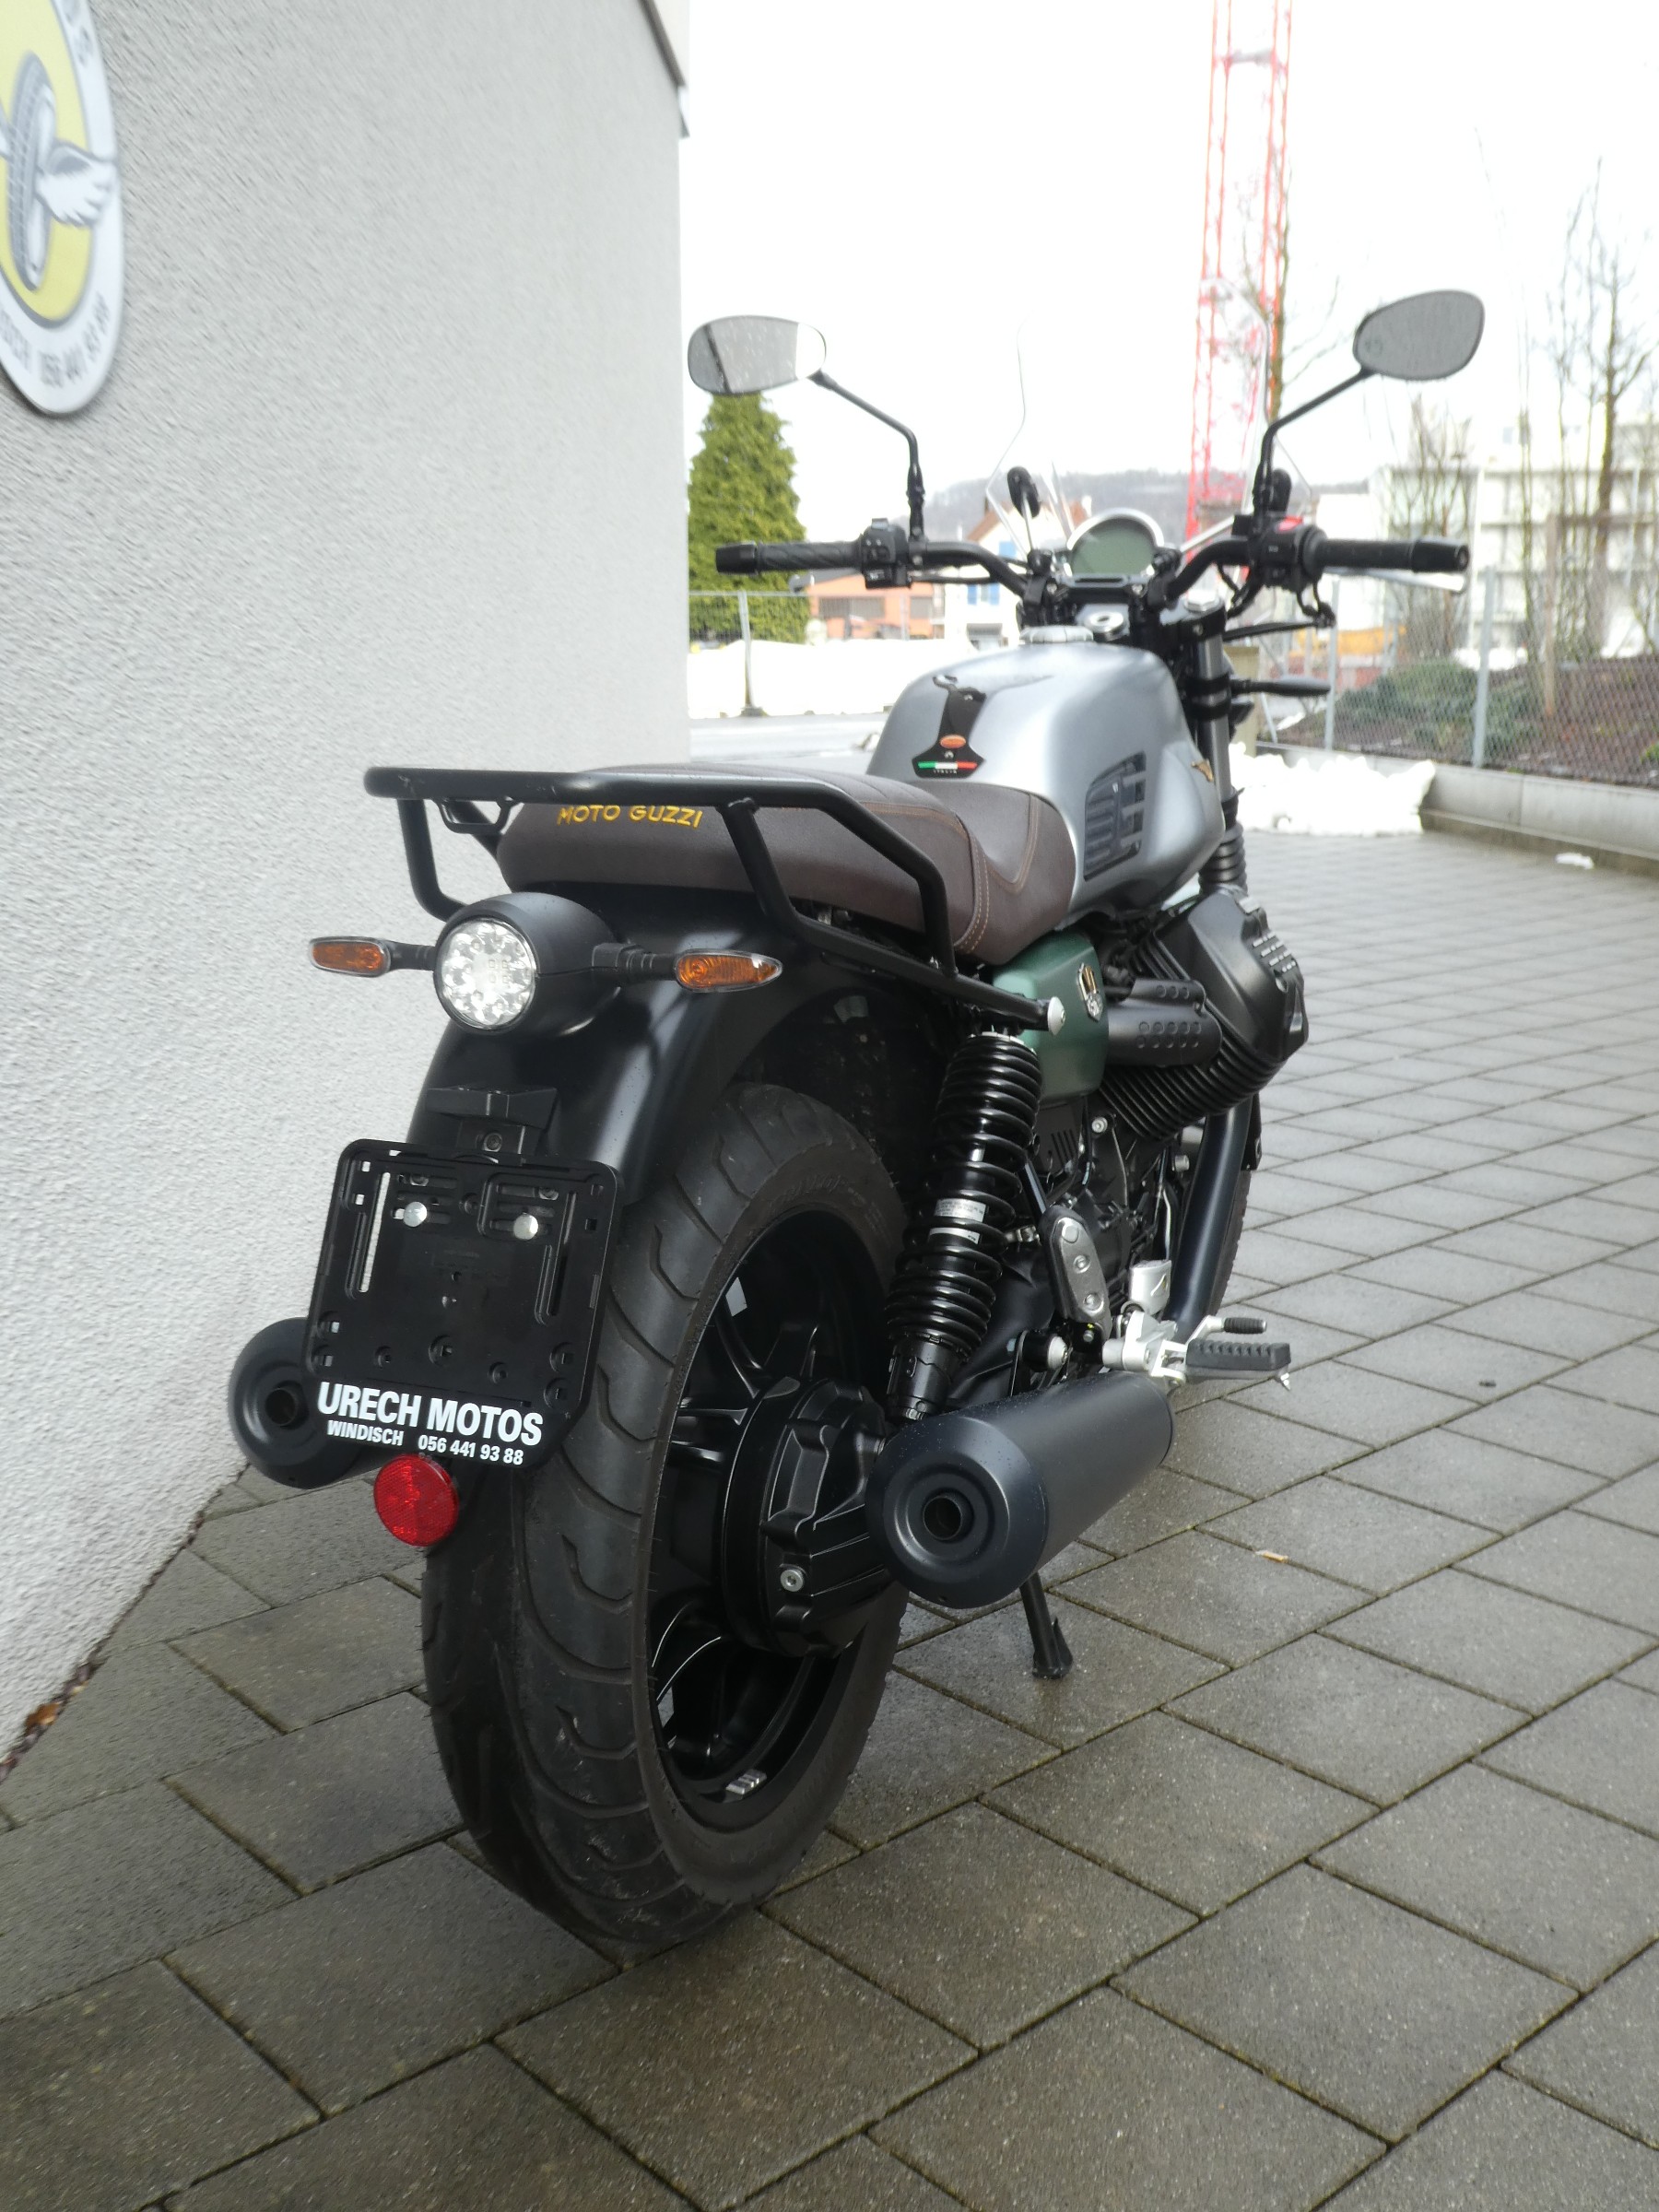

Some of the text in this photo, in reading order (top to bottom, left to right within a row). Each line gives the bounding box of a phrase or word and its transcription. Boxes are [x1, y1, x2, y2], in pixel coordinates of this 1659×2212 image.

[557, 804, 703, 829] MOTO GUZZI
[317, 1381, 544, 1446] URECH MOTOS
[326, 1419, 524, 1465] WINDISCH 056 441 93 88
